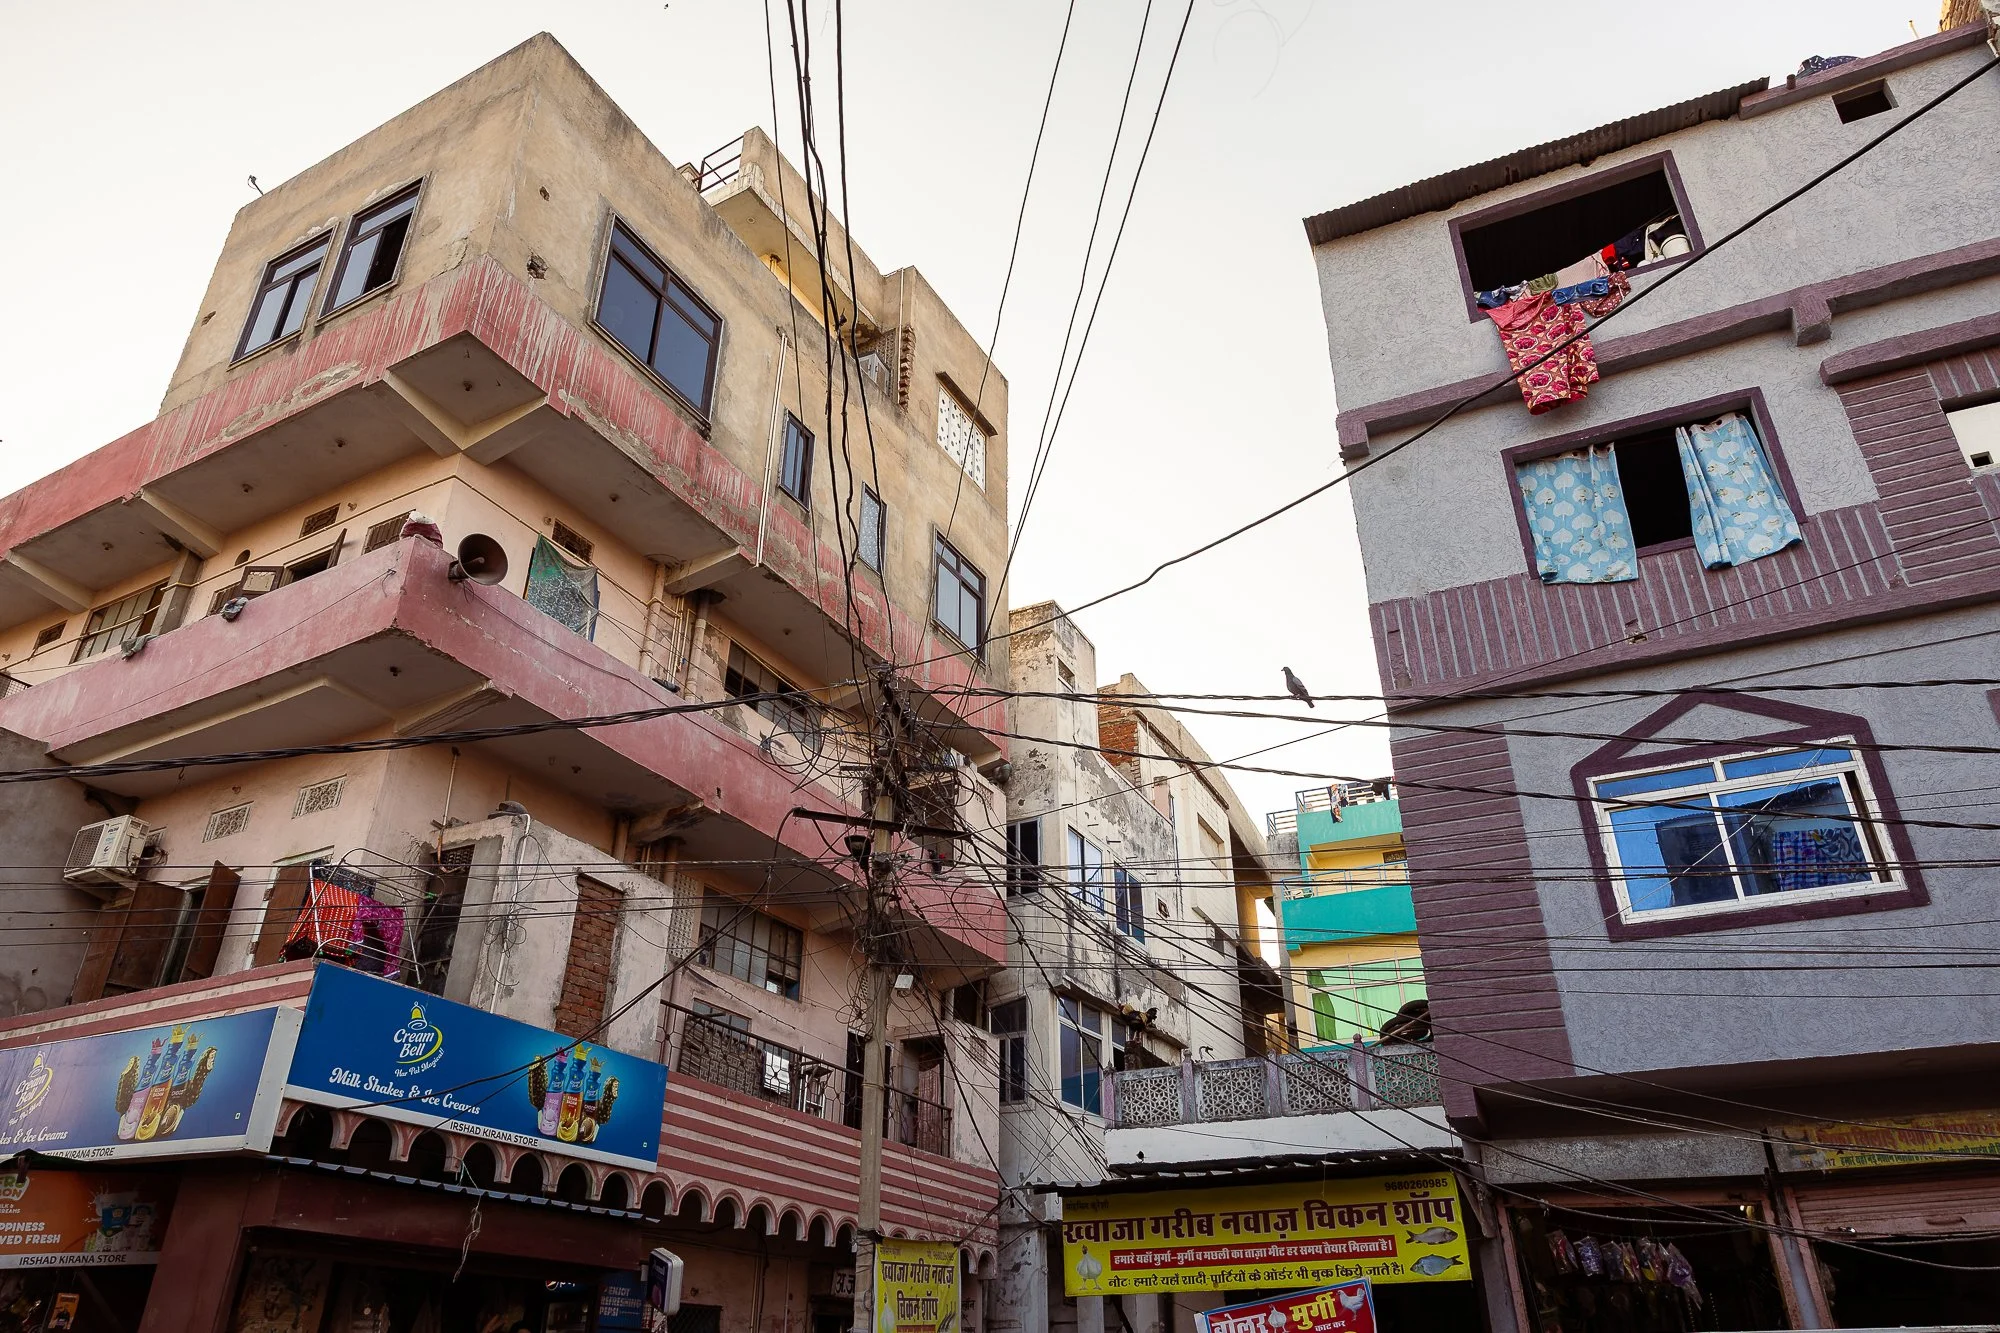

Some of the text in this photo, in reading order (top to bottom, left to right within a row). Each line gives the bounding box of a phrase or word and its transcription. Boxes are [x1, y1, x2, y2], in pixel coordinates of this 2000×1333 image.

[393, 1028, 435, 1044] Cream
[400, 1043, 426, 1058] Bell
[15, 1073, 48, 1096] Cream
[328, 1067, 481, 1115] Milk Shakes & Ice Creams
[16, 1086, 38, 1108] Bell
[38, 1126, 68, 1142] Creams
[450, 1121, 539, 1147] IRSHAD KIRANA STORE
[91, 1147, 116, 1158] STORE
[1384, 1178, 1448, 1192] 9680260985
[1063, 1191, 1455, 1244] ख्वाजा गरीब नवाज़ चिकन शॉप
[25, 1234, 61, 1244] FRESH
[19, 1254, 127, 1266] IRSHAD KIRANA STORE
[1114, 1252, 1134, 1265] हमारे
[1195, 1251, 1202, 1261] व
[1203, 1248, 1230, 1261] मछली
[1231, 1248, 1244, 1259] का
[1245, 1247, 1267, 1260] ताज़ा
[1268, 1242, 1286, 1257] मीट
[1286, 1246, 1298, 1256] हर
[1300, 1244, 1323, 1255] समय
[1324, 1240, 1347, 1254] तैयार
[1348, 1240, 1379, 1252] मिलता
[880, 1257, 954, 1288] ख्वाजा गरीब नवाज़
[1134, 1274, 1158, 1287] हमारे
[1248, 1268, 1261, 1282] के
[1295, 1264, 1309, 1280] भी
[1311, 1267, 1334, 1282] बुक
[1366, 1262, 1391, 1276] जाते
[600, 1306, 620, 1316] PEPSI
[896, 1290, 920, 1320] चिकन
[921, 1290, 938, 1320] शॉप
[1289, 1292, 1336, 1331] मुर्गी
[1332, 1320, 1346, 1329] कर
